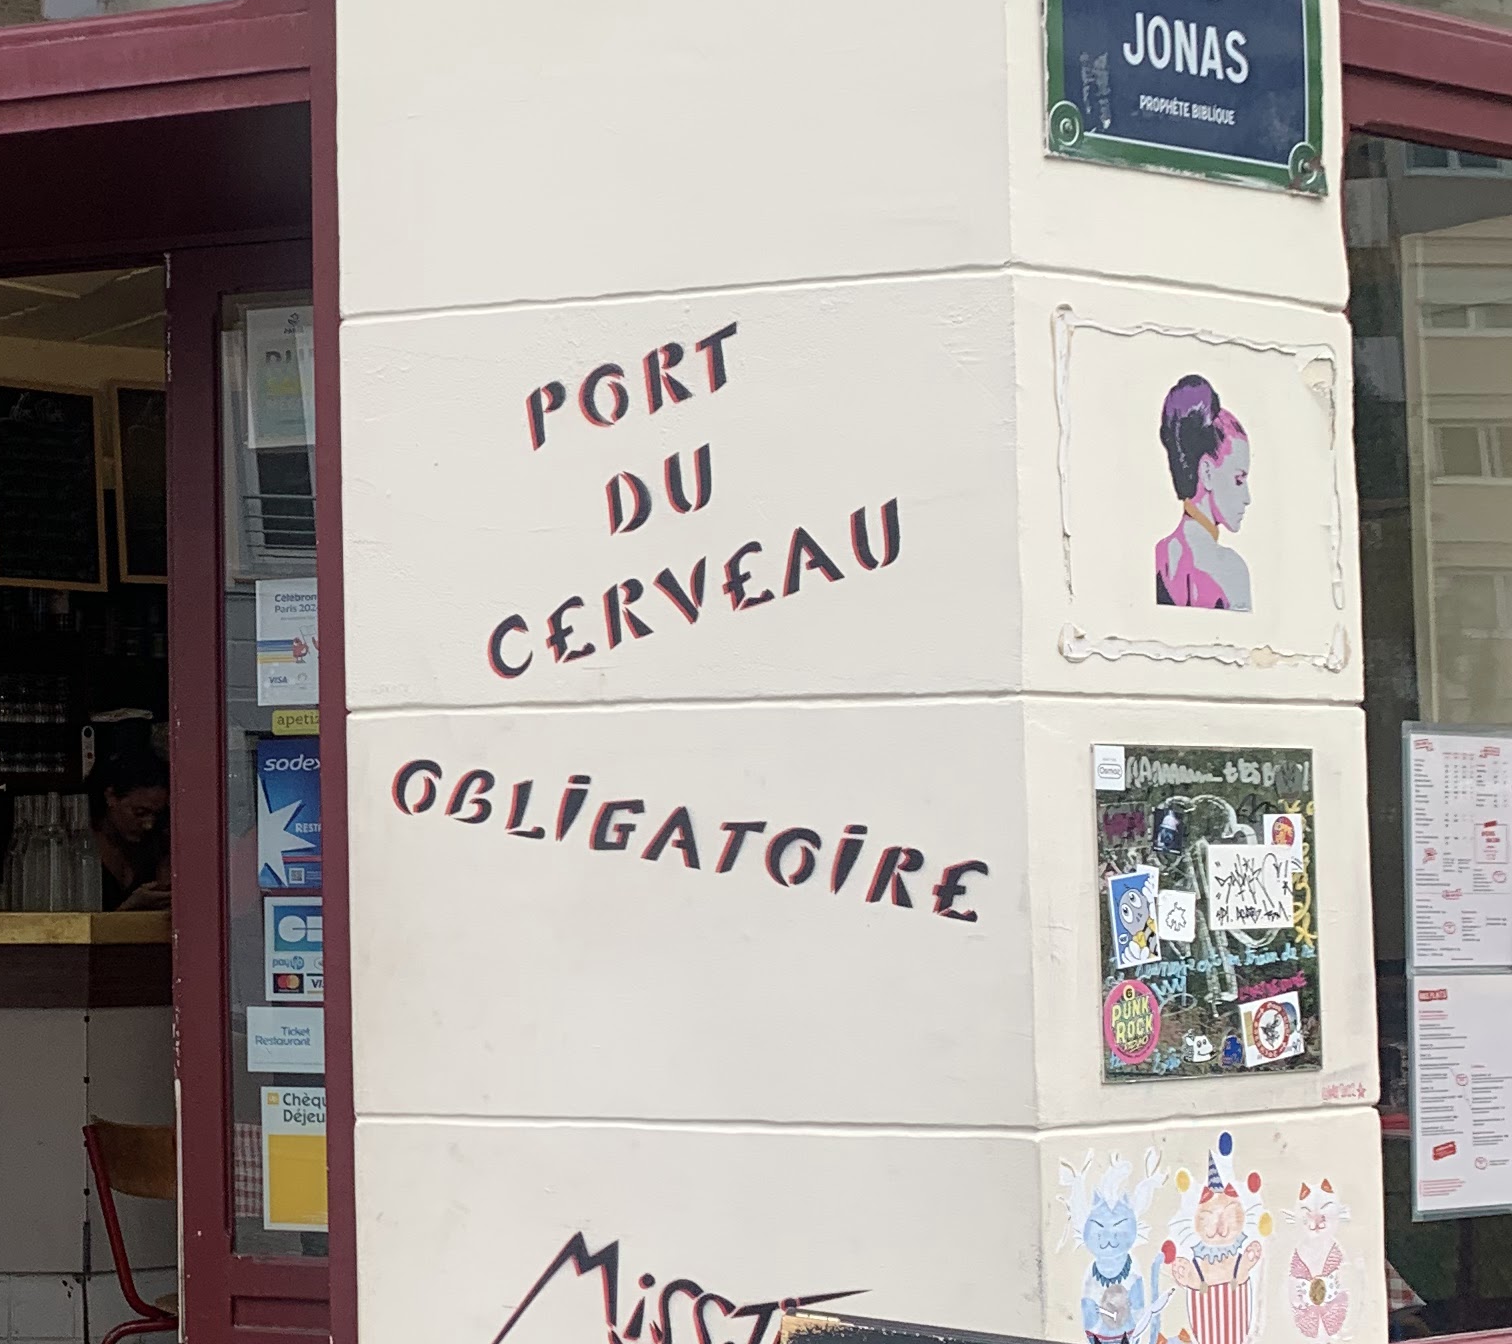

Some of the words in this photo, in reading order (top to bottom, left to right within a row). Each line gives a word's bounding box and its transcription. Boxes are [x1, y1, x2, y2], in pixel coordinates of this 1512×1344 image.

[1122, 12, 1250, 85] JONAS
[525, 320, 738, 452] PORT
[605, 442, 713, 536] DU
[488, 496, 902, 680] CERVEAU
[299, 603, 318, 613] 202
[1111, 995, 1150, 1028] PUNK
[255, 1035, 311, 1047] Restaurant
[280, 1026, 311, 1037] Ticket
[1115, 1013, 1154, 1044] ROCK
